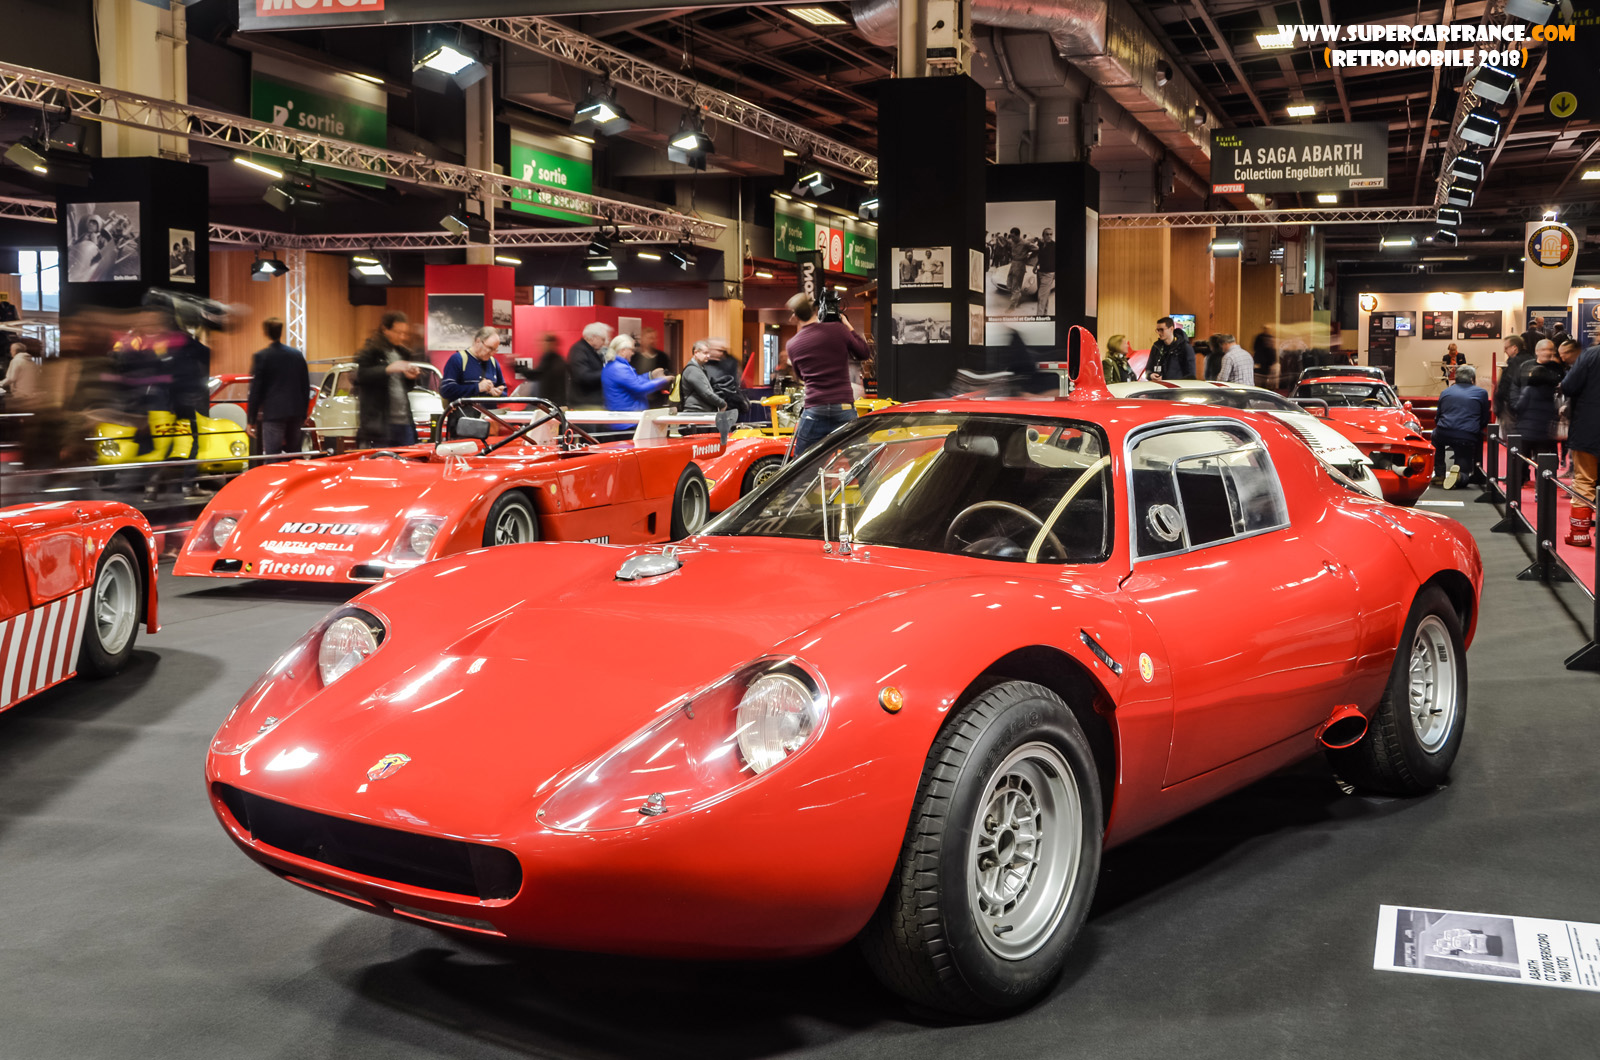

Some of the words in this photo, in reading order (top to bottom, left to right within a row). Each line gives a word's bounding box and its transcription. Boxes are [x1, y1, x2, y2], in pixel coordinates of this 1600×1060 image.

[298, 112, 345, 136] sortie
[1234, 148, 1253, 166] LA
[1257, 146, 1297, 165] SAGA
[1301, 143, 1363, 162] ABARTH
[538, 167, 567, 186] sortie
[1234, 167, 1283, 181] Collection
[1285, 165, 1333, 181] Engelbert
[1335, 161, 1363, 177] MÖLL
[1214, 184, 1244, 193] MOTUL
[692, 443, 720, 459] Firestone
[278, 522, 359, 535] MOTUL
[259, 540, 308, 552] ABARTH
[309, 541, 354, 553] OSELLA
[258, 559, 335, 577] Firestone
[1537, 933, 1552, 961] PERISCOPIO
[1526, 959, 1541, 981] ABARTH
[1542, 960, 1556, 974] 2000
[1544, 973, 1557, 981] OT
